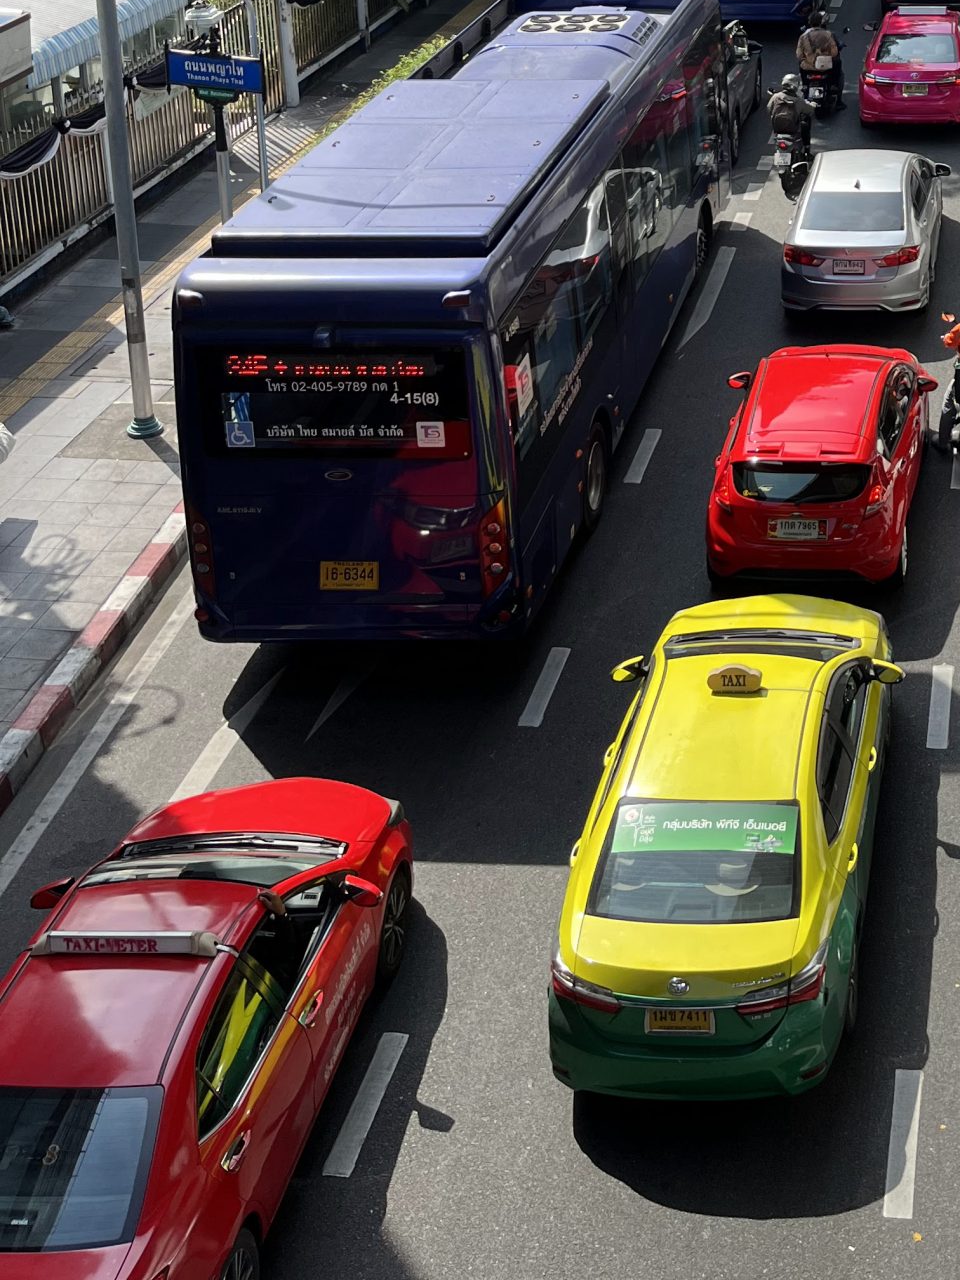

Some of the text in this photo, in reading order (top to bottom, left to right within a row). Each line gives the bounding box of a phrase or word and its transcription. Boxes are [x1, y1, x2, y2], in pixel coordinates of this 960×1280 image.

[184, 60, 244, 77] ถนนพญาไท
[187, 73, 209, 81] Thanon
[211, 76, 229, 84] Phaya
[266, 378, 399, 392] โทร 02-405-9789 กด 1
[266, 424, 404, 437] บริษัท ไทย สมายล์ บัส จำกัด
[797, 521, 817, 530] 7965
[325, 567, 375, 581] 16-6344
[720, 674, 747, 687] TAXI
[663, 818, 713, 832] กลุ่มบริษัท
[716, 818, 740, 830] พีทีจี
[678, 1010, 708, 1023] 7411
